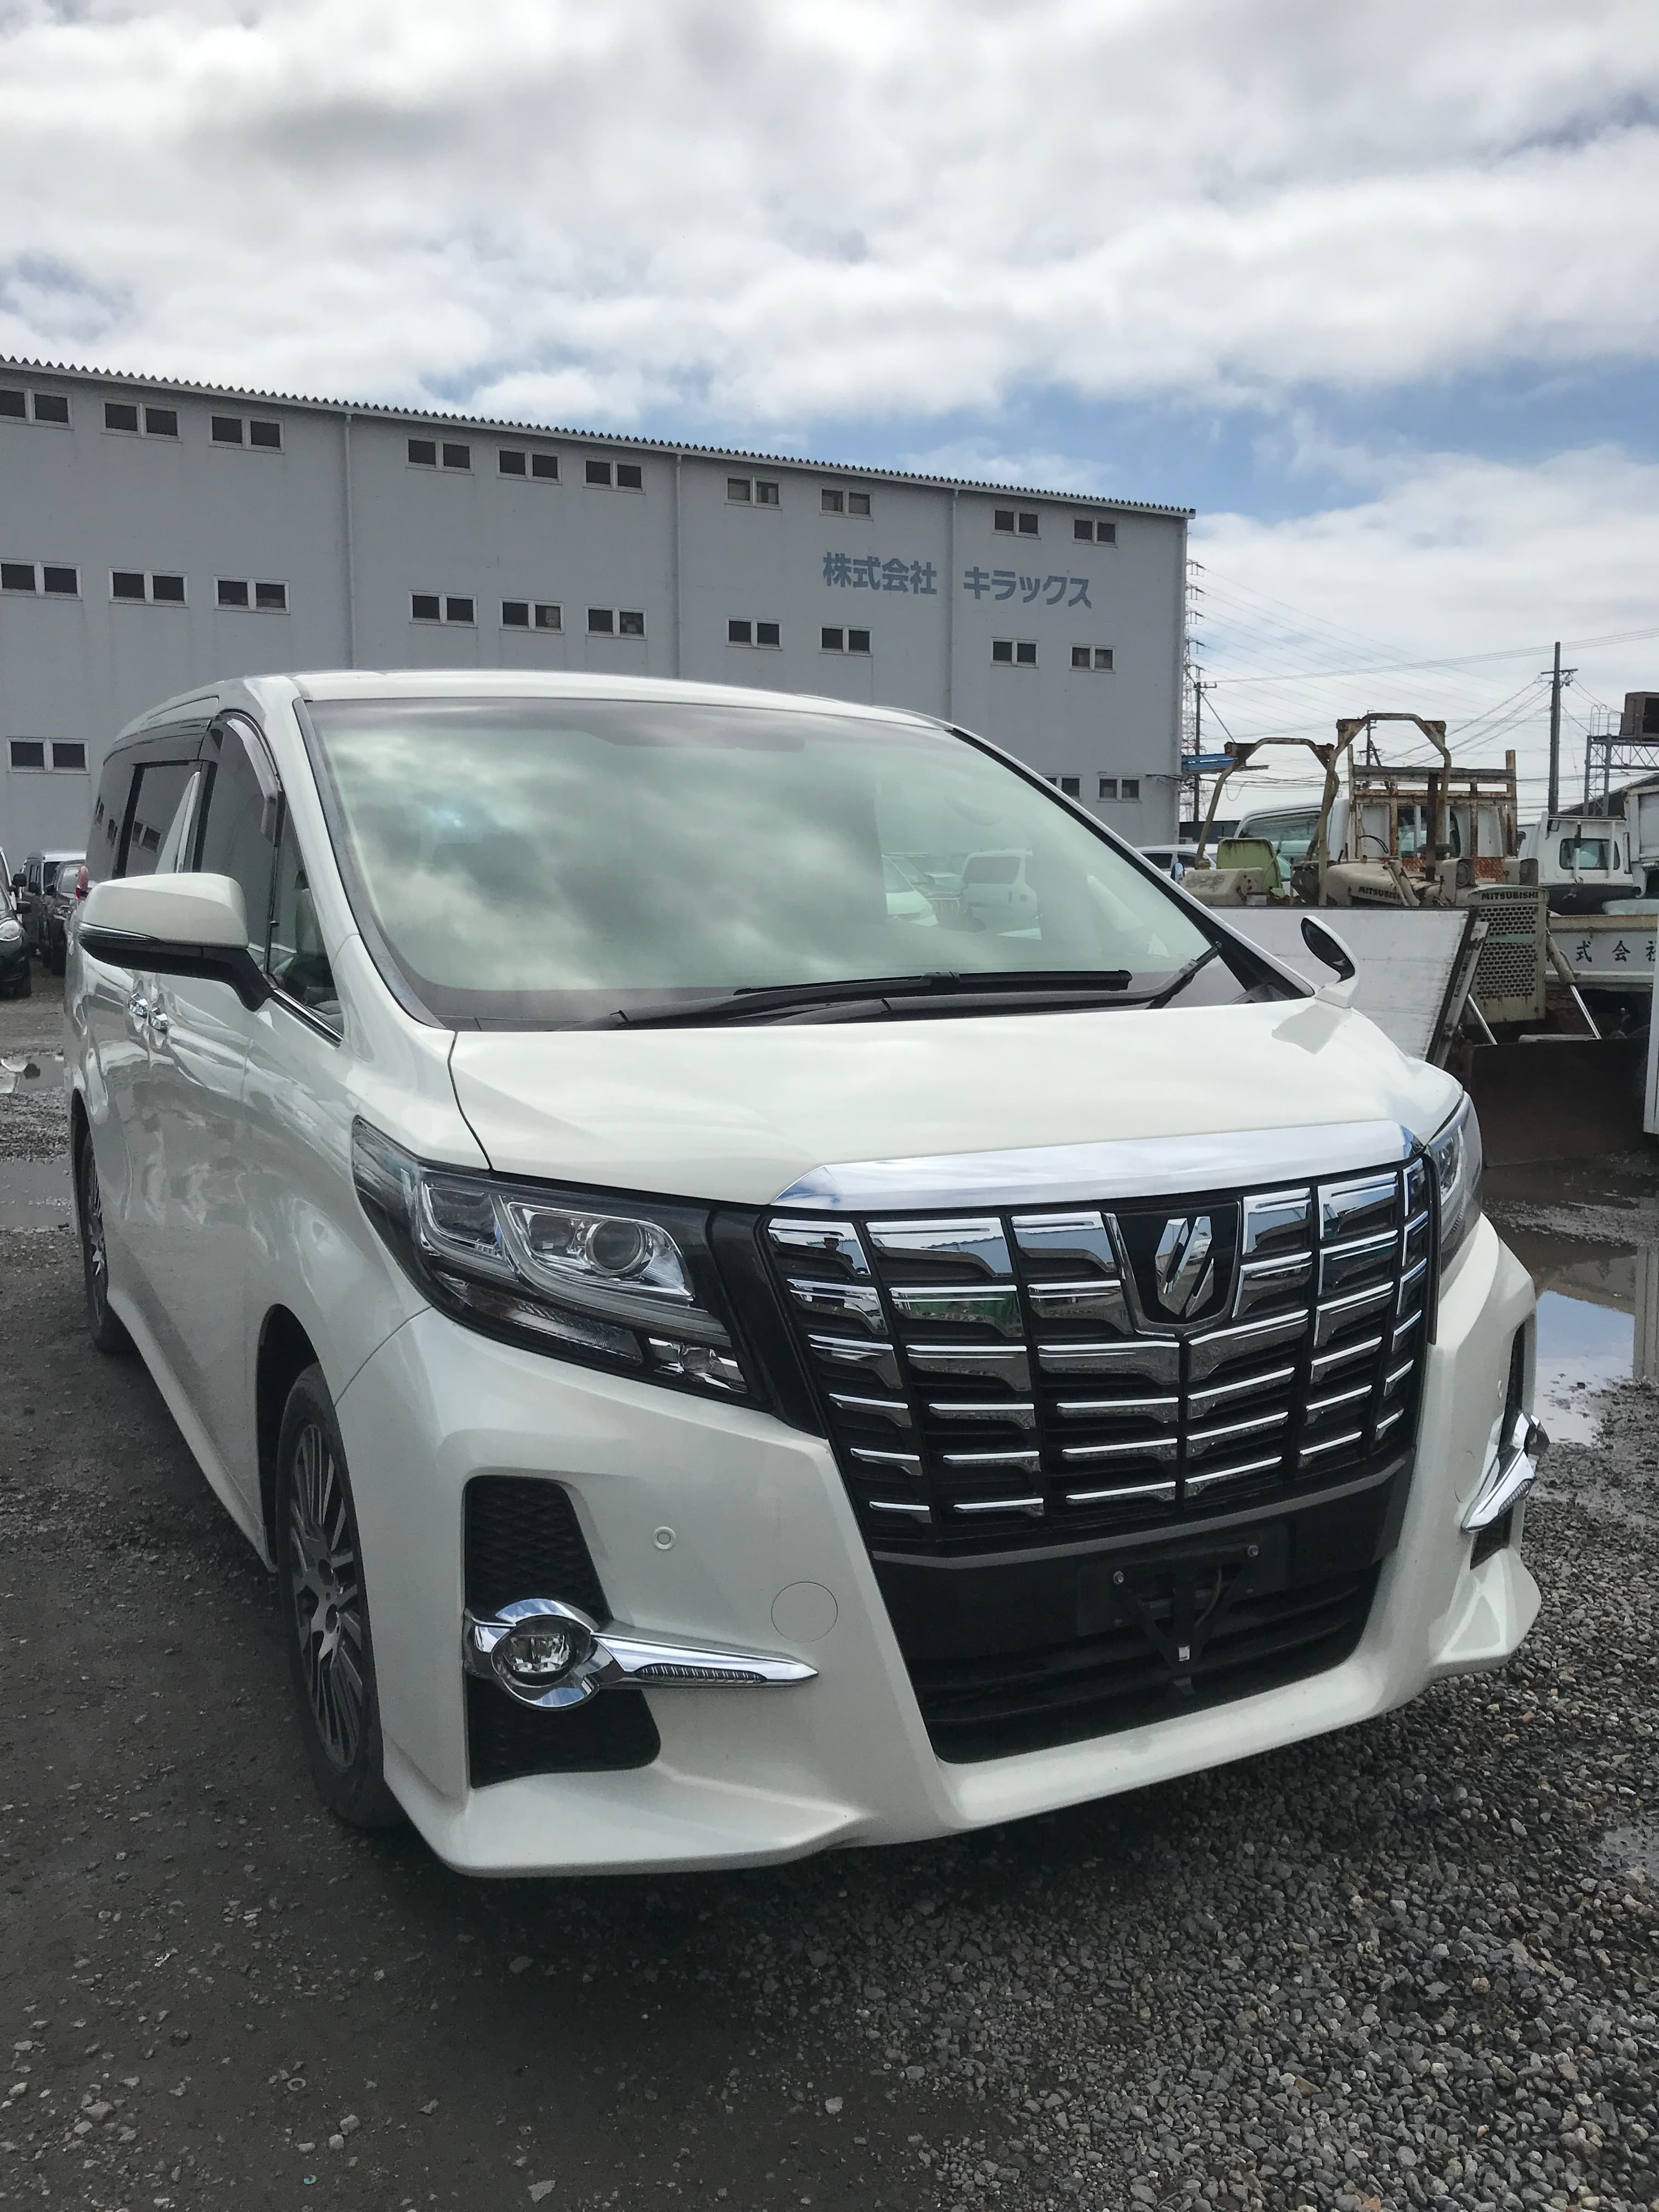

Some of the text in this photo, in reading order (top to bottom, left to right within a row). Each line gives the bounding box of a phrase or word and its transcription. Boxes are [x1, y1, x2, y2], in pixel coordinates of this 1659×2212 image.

[823, 552, 1092, 610] 株式会社 キラックス
[1358, 886, 1400, 900] MITSUBIS
[1481, 891, 1539, 900] MITSUBISHI
